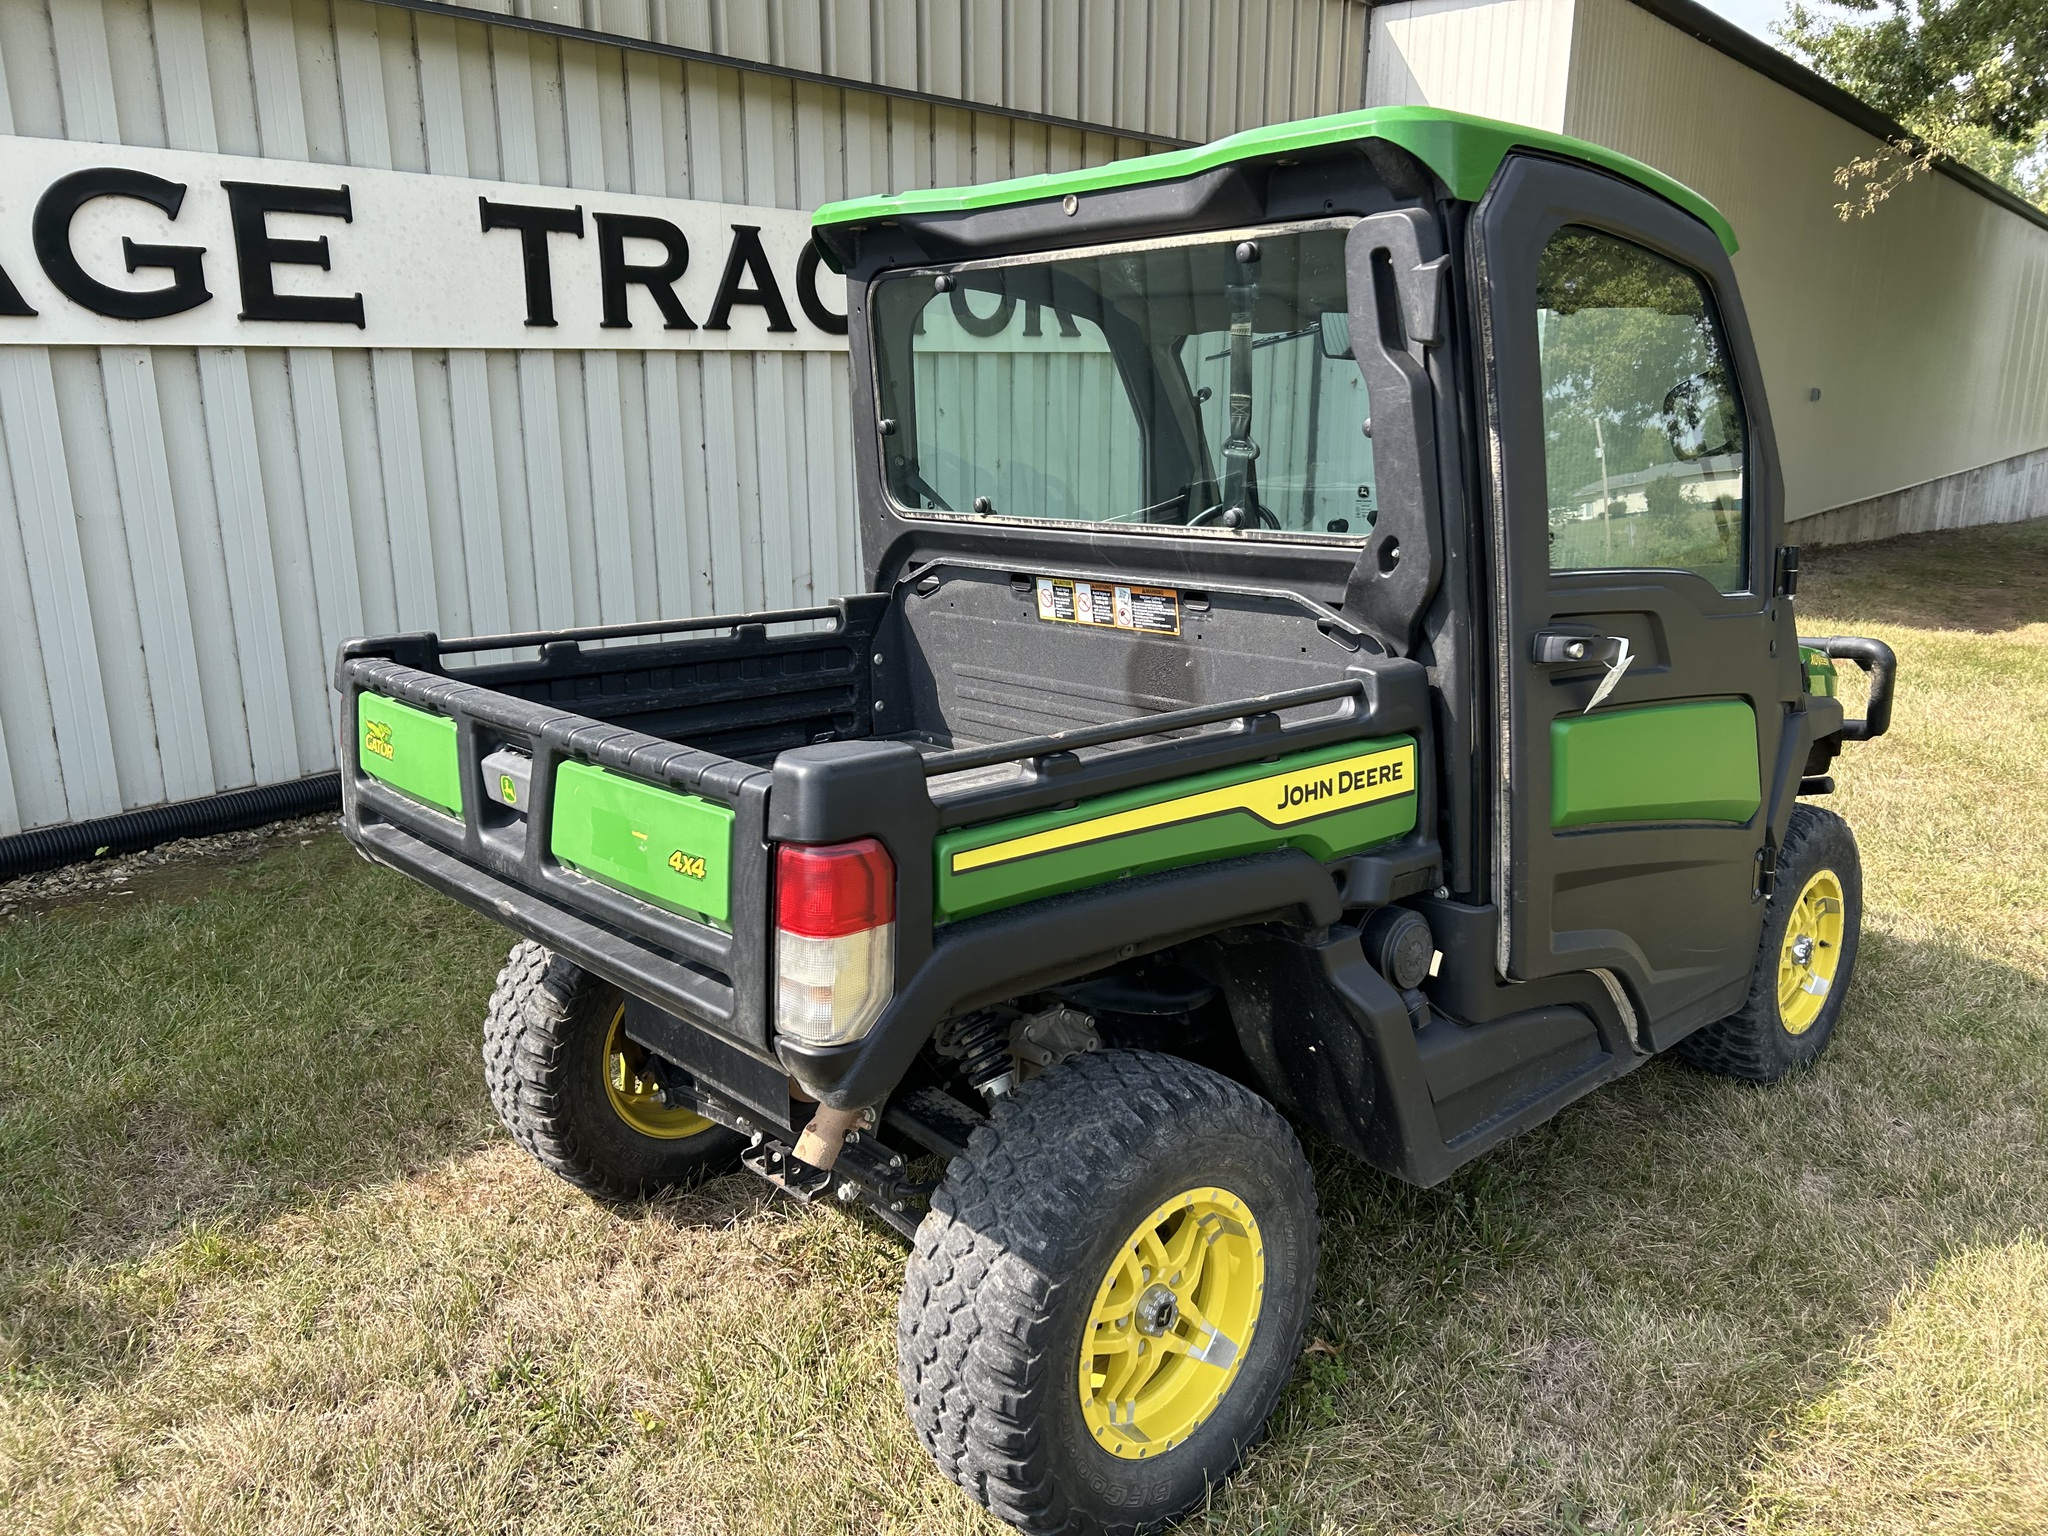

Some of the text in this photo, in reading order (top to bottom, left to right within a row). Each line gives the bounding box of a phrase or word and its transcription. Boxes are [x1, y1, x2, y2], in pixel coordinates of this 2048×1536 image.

[0, 167, 368, 330] GE
[365, 731, 394, 760] GATOR
[1277, 761, 1403, 810] JOHN DEERE
